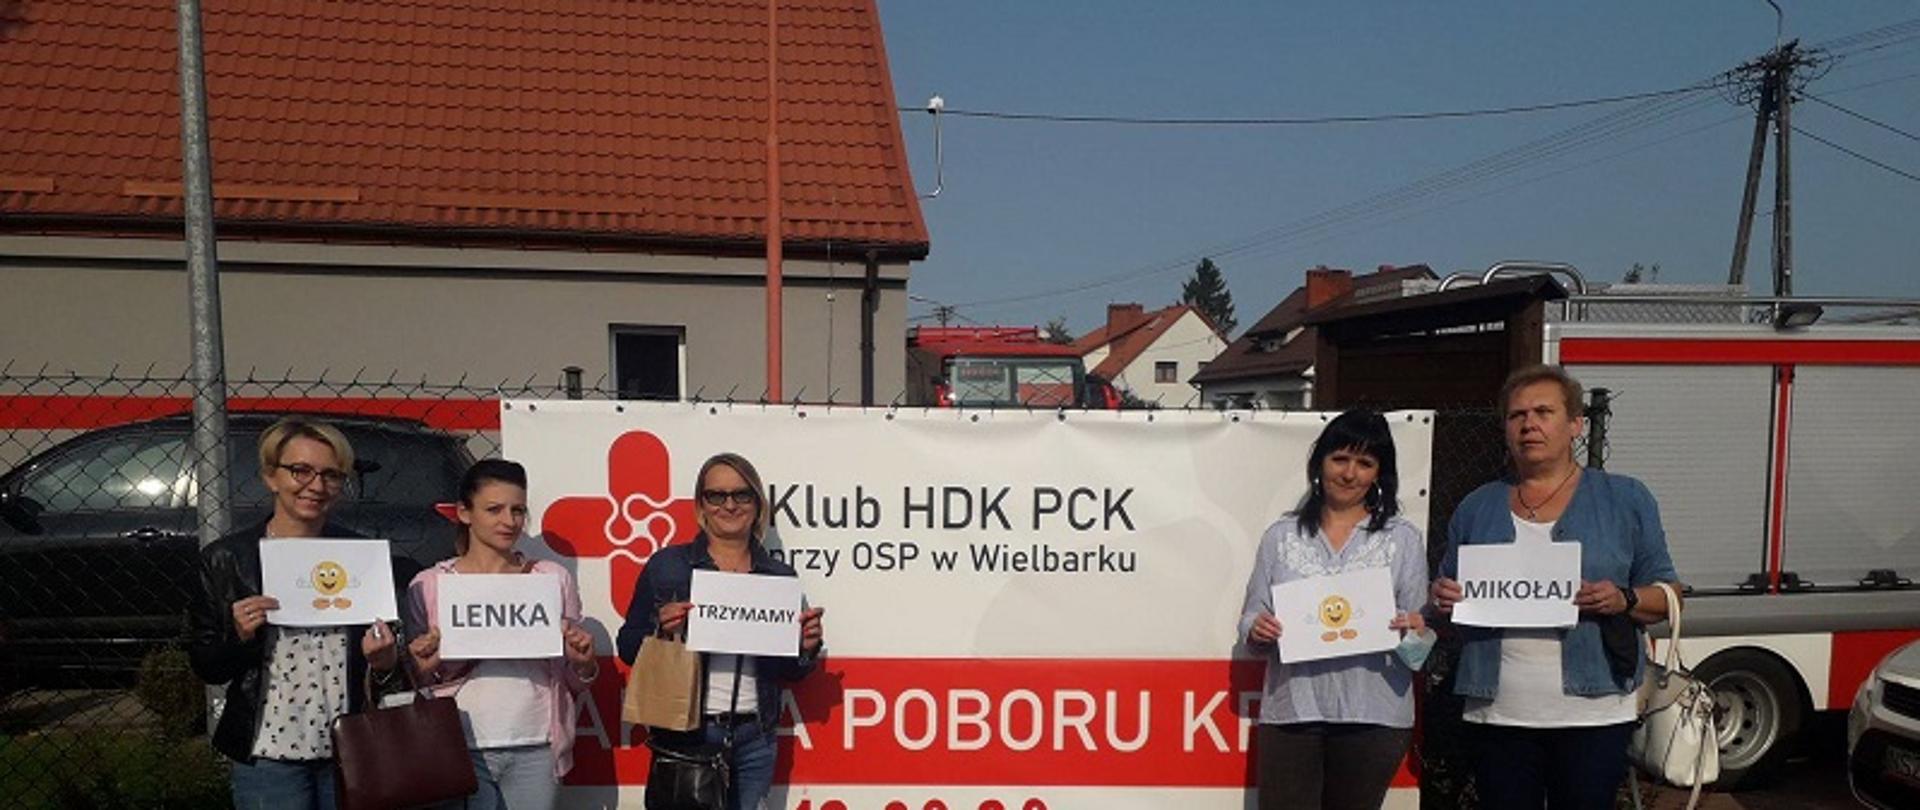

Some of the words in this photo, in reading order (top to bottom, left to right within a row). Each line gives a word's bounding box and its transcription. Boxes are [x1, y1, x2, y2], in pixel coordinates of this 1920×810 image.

[769, 484, 881, 529] Klub
[904, 486, 1012, 531] HDK
[1033, 487, 1136, 531] PCK
[852, 542, 920, 571] OSP
[931, 551, 959, 571] w
[969, 544, 1136, 572] Wielbarku
[1464, 580, 1573, 600] MIKOŁAJ
[452, 603, 550, 628] LENKA
[698, 604, 795, 624] TRZYMAMY
[842, 688, 1150, 752] POBORU
